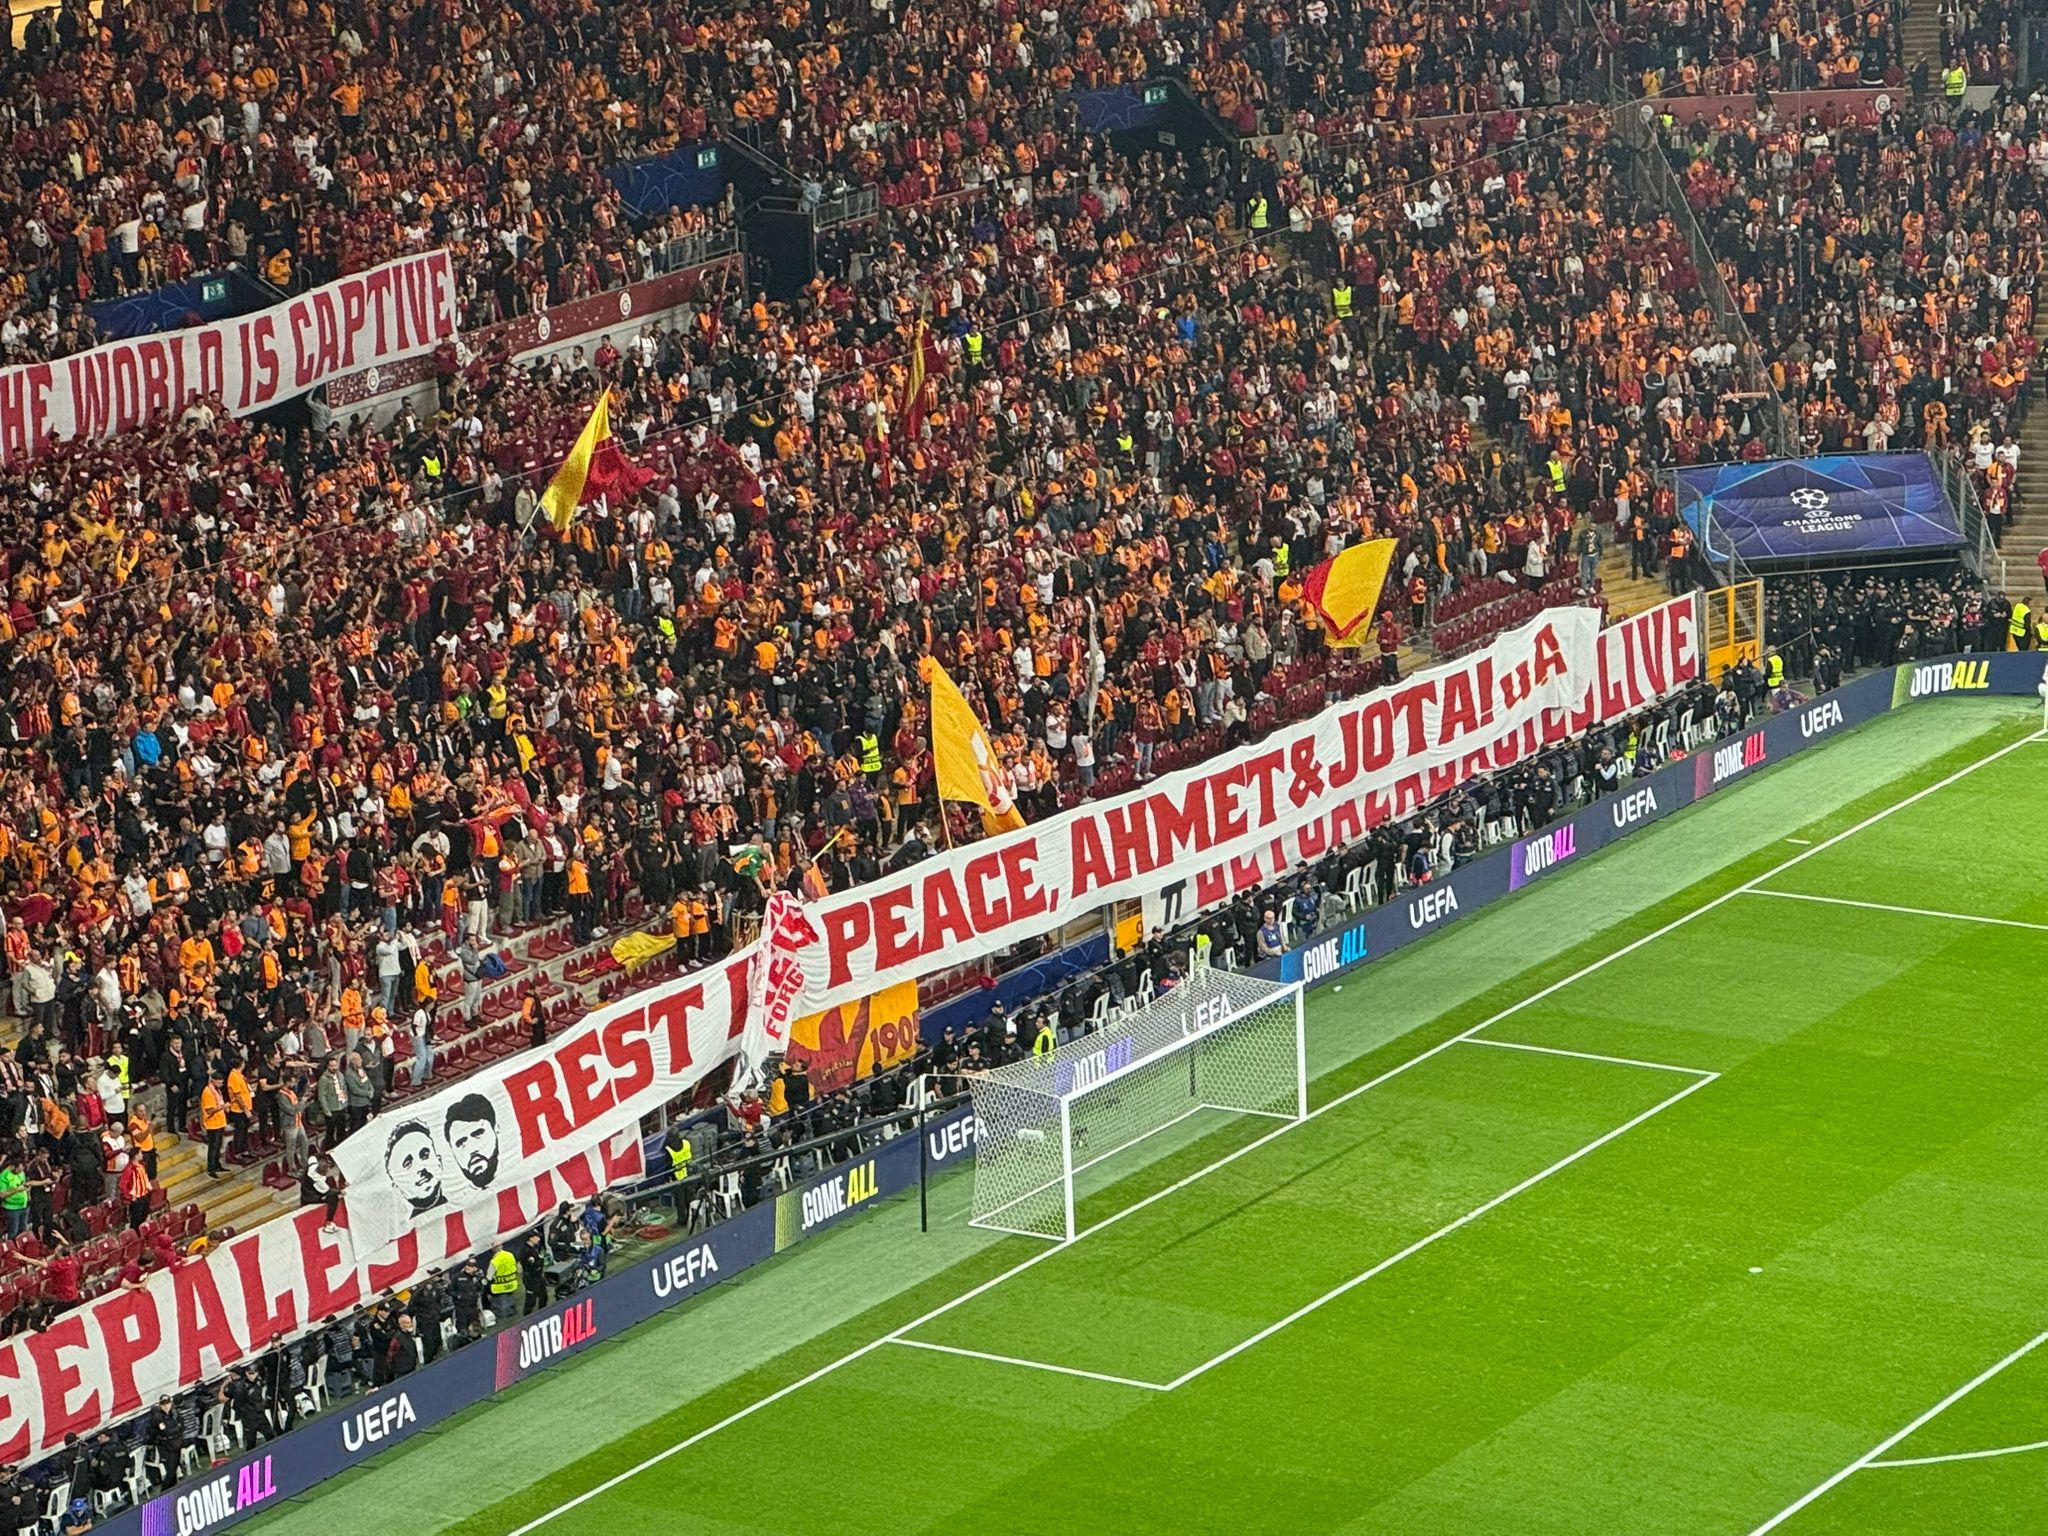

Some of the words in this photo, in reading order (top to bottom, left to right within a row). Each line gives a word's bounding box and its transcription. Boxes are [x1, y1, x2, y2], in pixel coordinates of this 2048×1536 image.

[68, 330, 224, 438] WORLD
[237, 314, 278, 410] IS
[288, 254, 453, 387] CAPTIVE
[1783, 513, 1863, 527] CHAMPIONS
[1800, 521, 1853, 534] LEAGUE
[502, 984, 704, 1159] REST
[821, 838, 1059, 991] PEACE,
[236, 1454, 277, 1511] ALL
[342, 1392, 416, 1452] UEFA
[652, 1244, 718, 1298] UEFA
[847, 1160, 879, 1207] ALL
[930, 1115, 989, 1161] UEFA
[1340, 924, 1367, 966] ALL
[1409, 886, 1458, 929] UEFA
[1613, 787, 1657, 828] UEFA
[1744, 731, 1766, 767] ALL
[1801, 700, 1843, 739] UEFA
